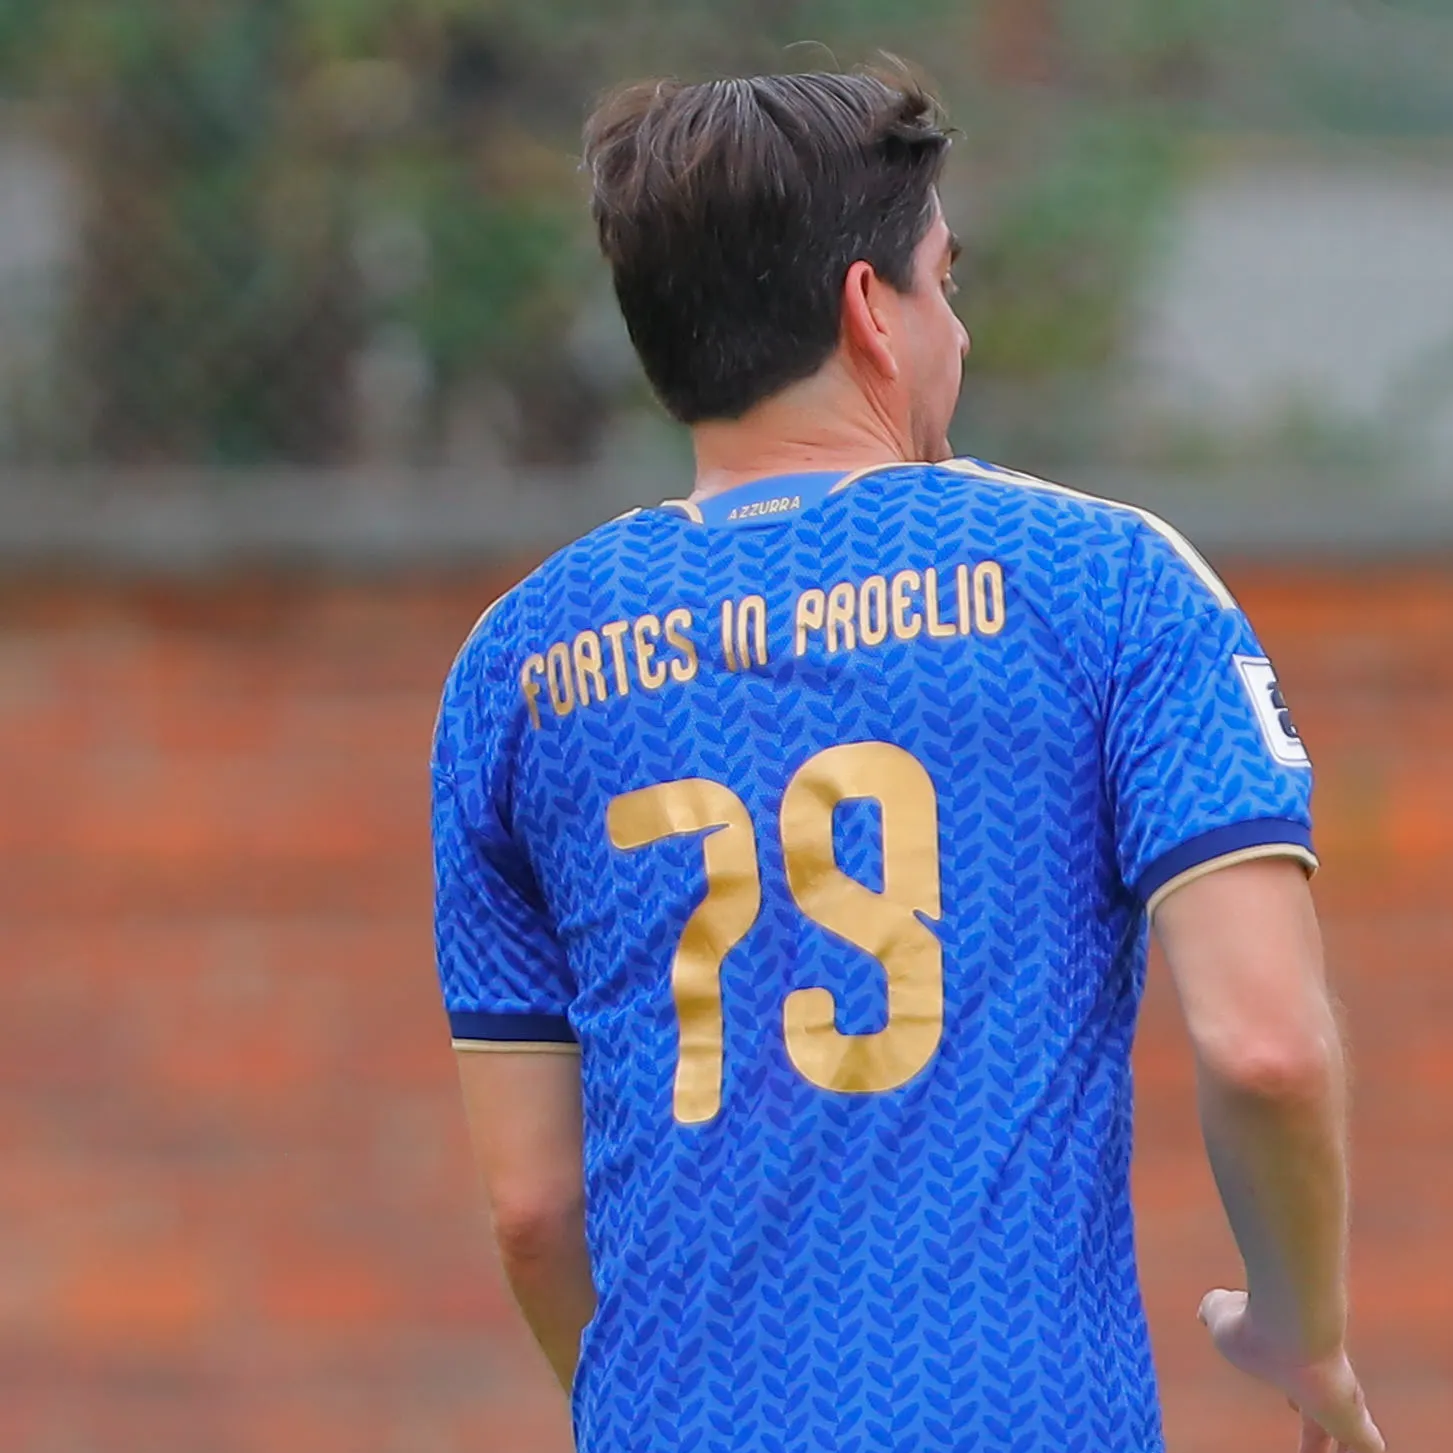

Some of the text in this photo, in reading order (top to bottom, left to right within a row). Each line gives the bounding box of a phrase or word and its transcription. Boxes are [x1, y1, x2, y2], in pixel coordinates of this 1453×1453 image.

[728, 496, 801, 520] AZZURRA
[520, 560, 1005, 730] FORTES IN PROELIO
